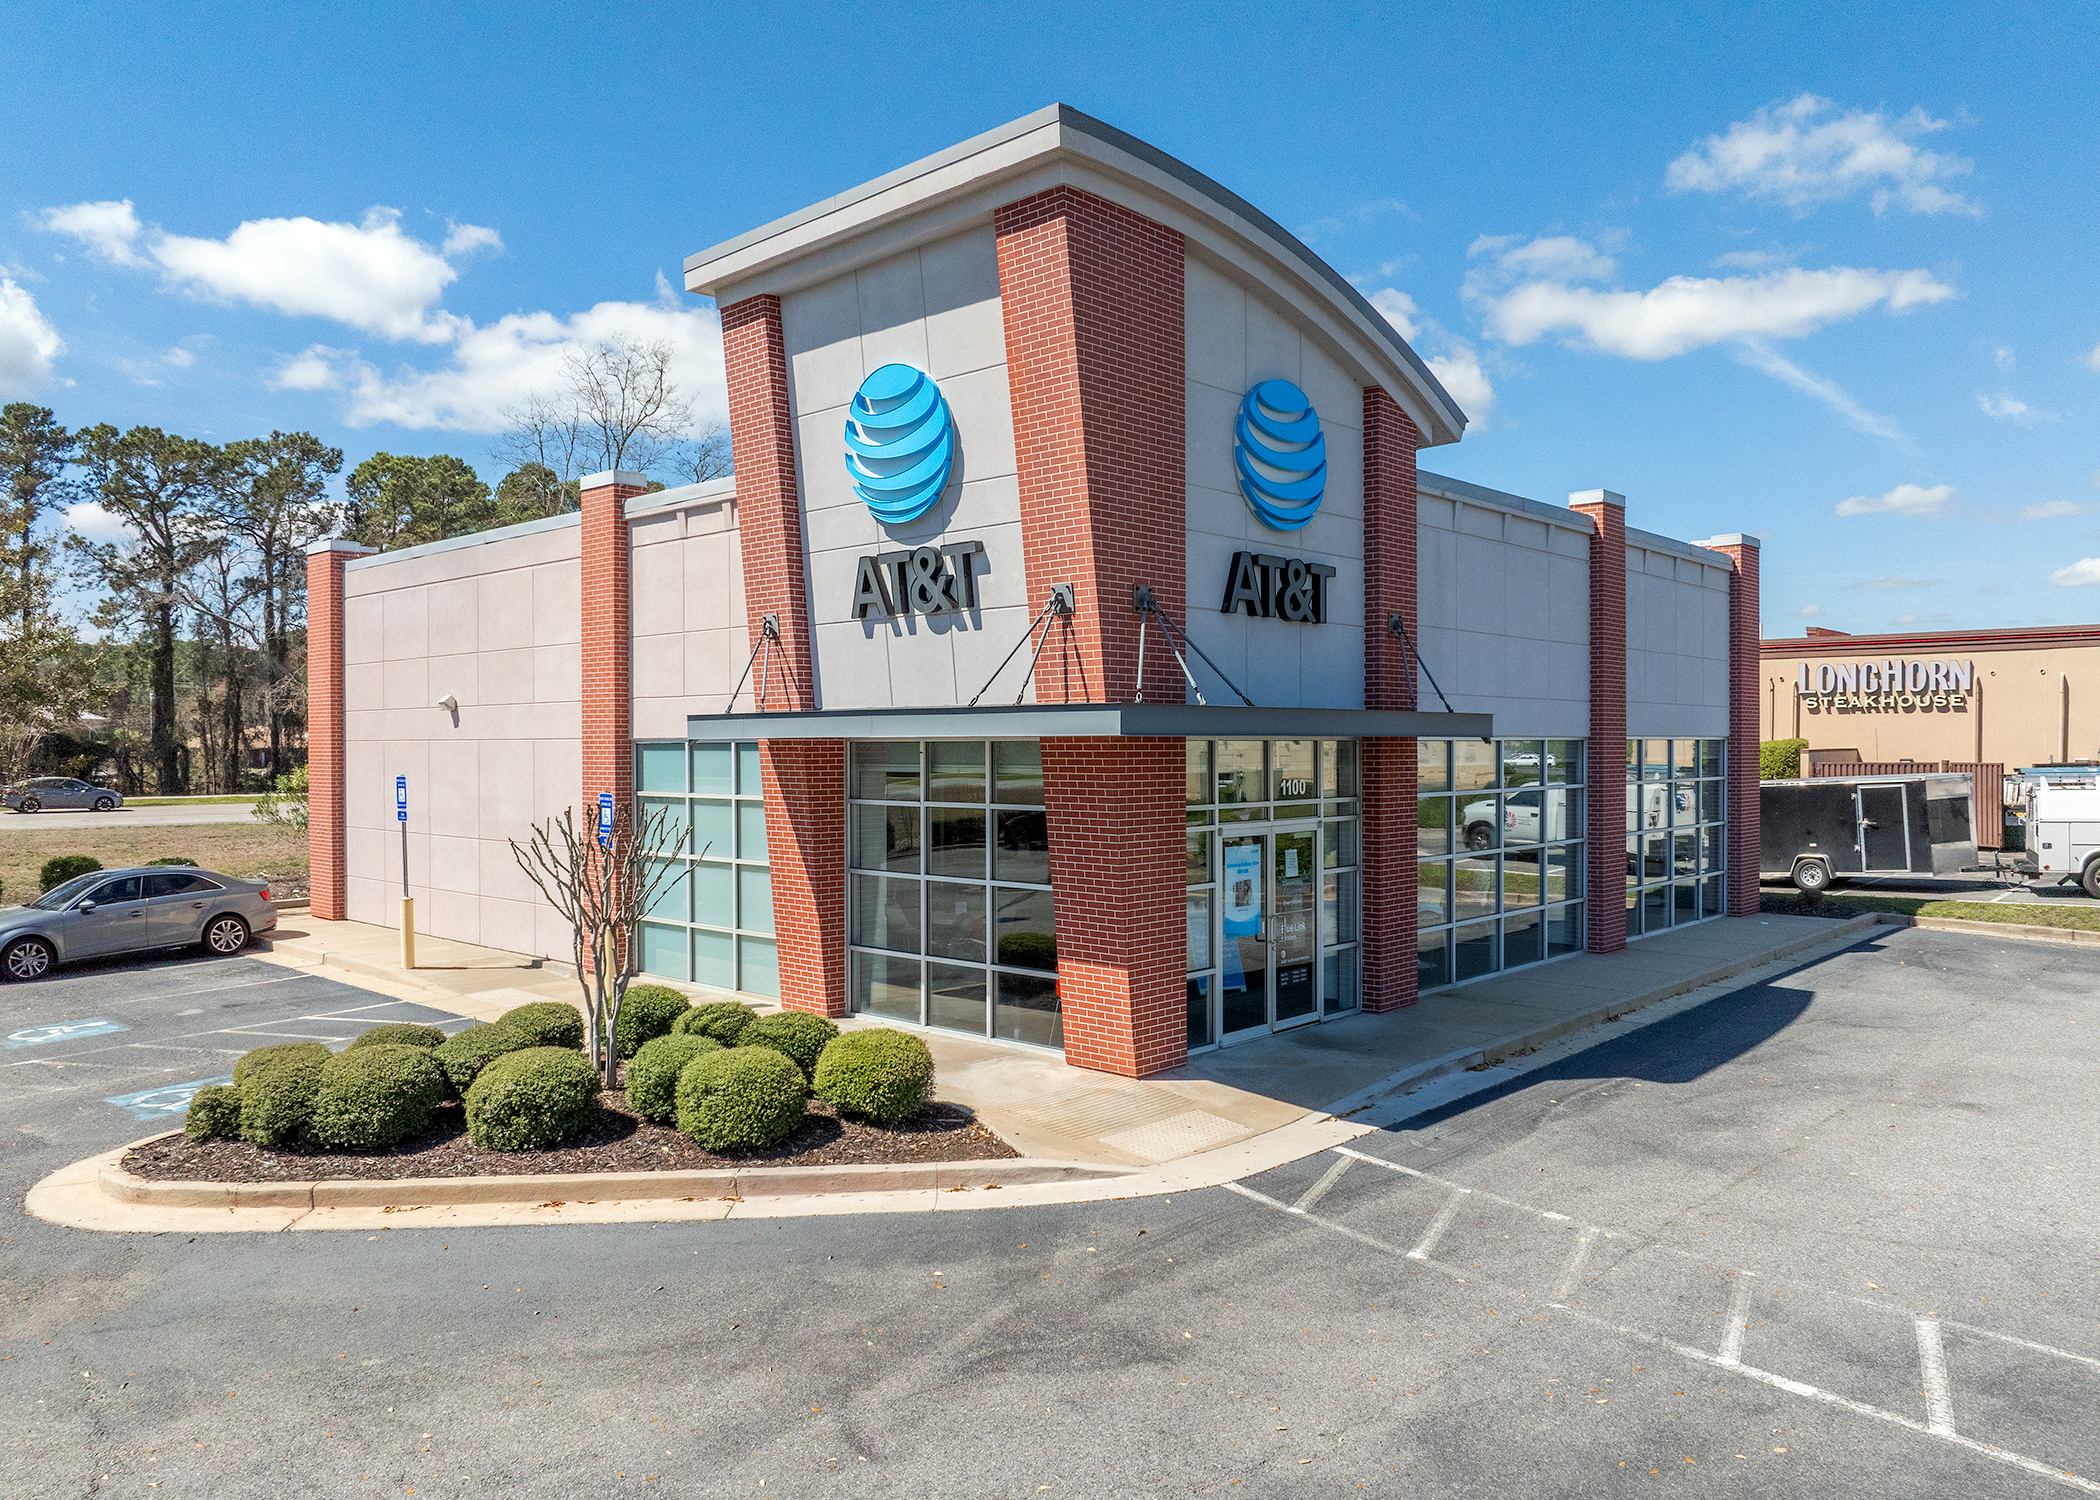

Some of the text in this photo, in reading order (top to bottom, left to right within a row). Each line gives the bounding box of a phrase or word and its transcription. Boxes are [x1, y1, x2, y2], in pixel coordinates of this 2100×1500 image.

[851, 540, 984, 619] AT&T
[1220, 551, 1337, 624] AT&T
[1798, 659, 1973, 695] LONGHORN
[1806, 694, 1965, 709] STEAKHOUSE
[1280, 779, 1306, 796] 1100
